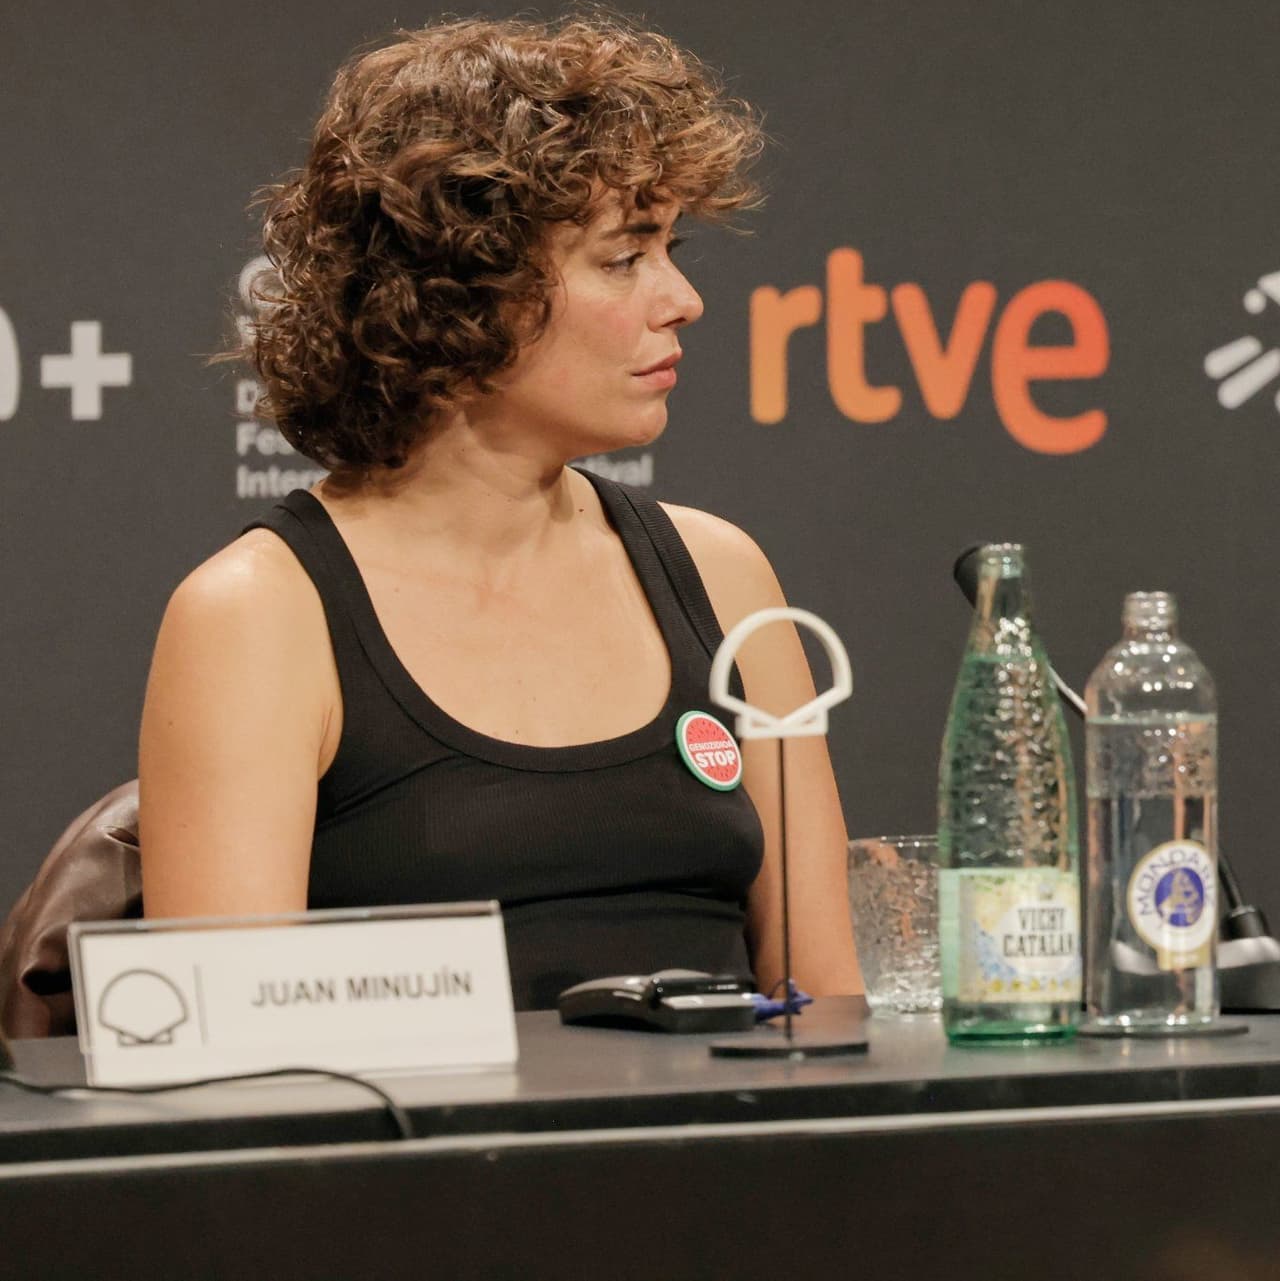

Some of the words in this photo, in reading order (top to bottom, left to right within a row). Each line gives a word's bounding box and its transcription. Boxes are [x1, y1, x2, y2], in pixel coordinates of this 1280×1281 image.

[750, 247, 1110, 455] rtve
[695, 750, 736, 768] STOP
[1018, 907, 1065, 931] VICHY
[251, 977, 336, 1008] JUAN
[347, 964, 474, 1001] MINUJÍN
